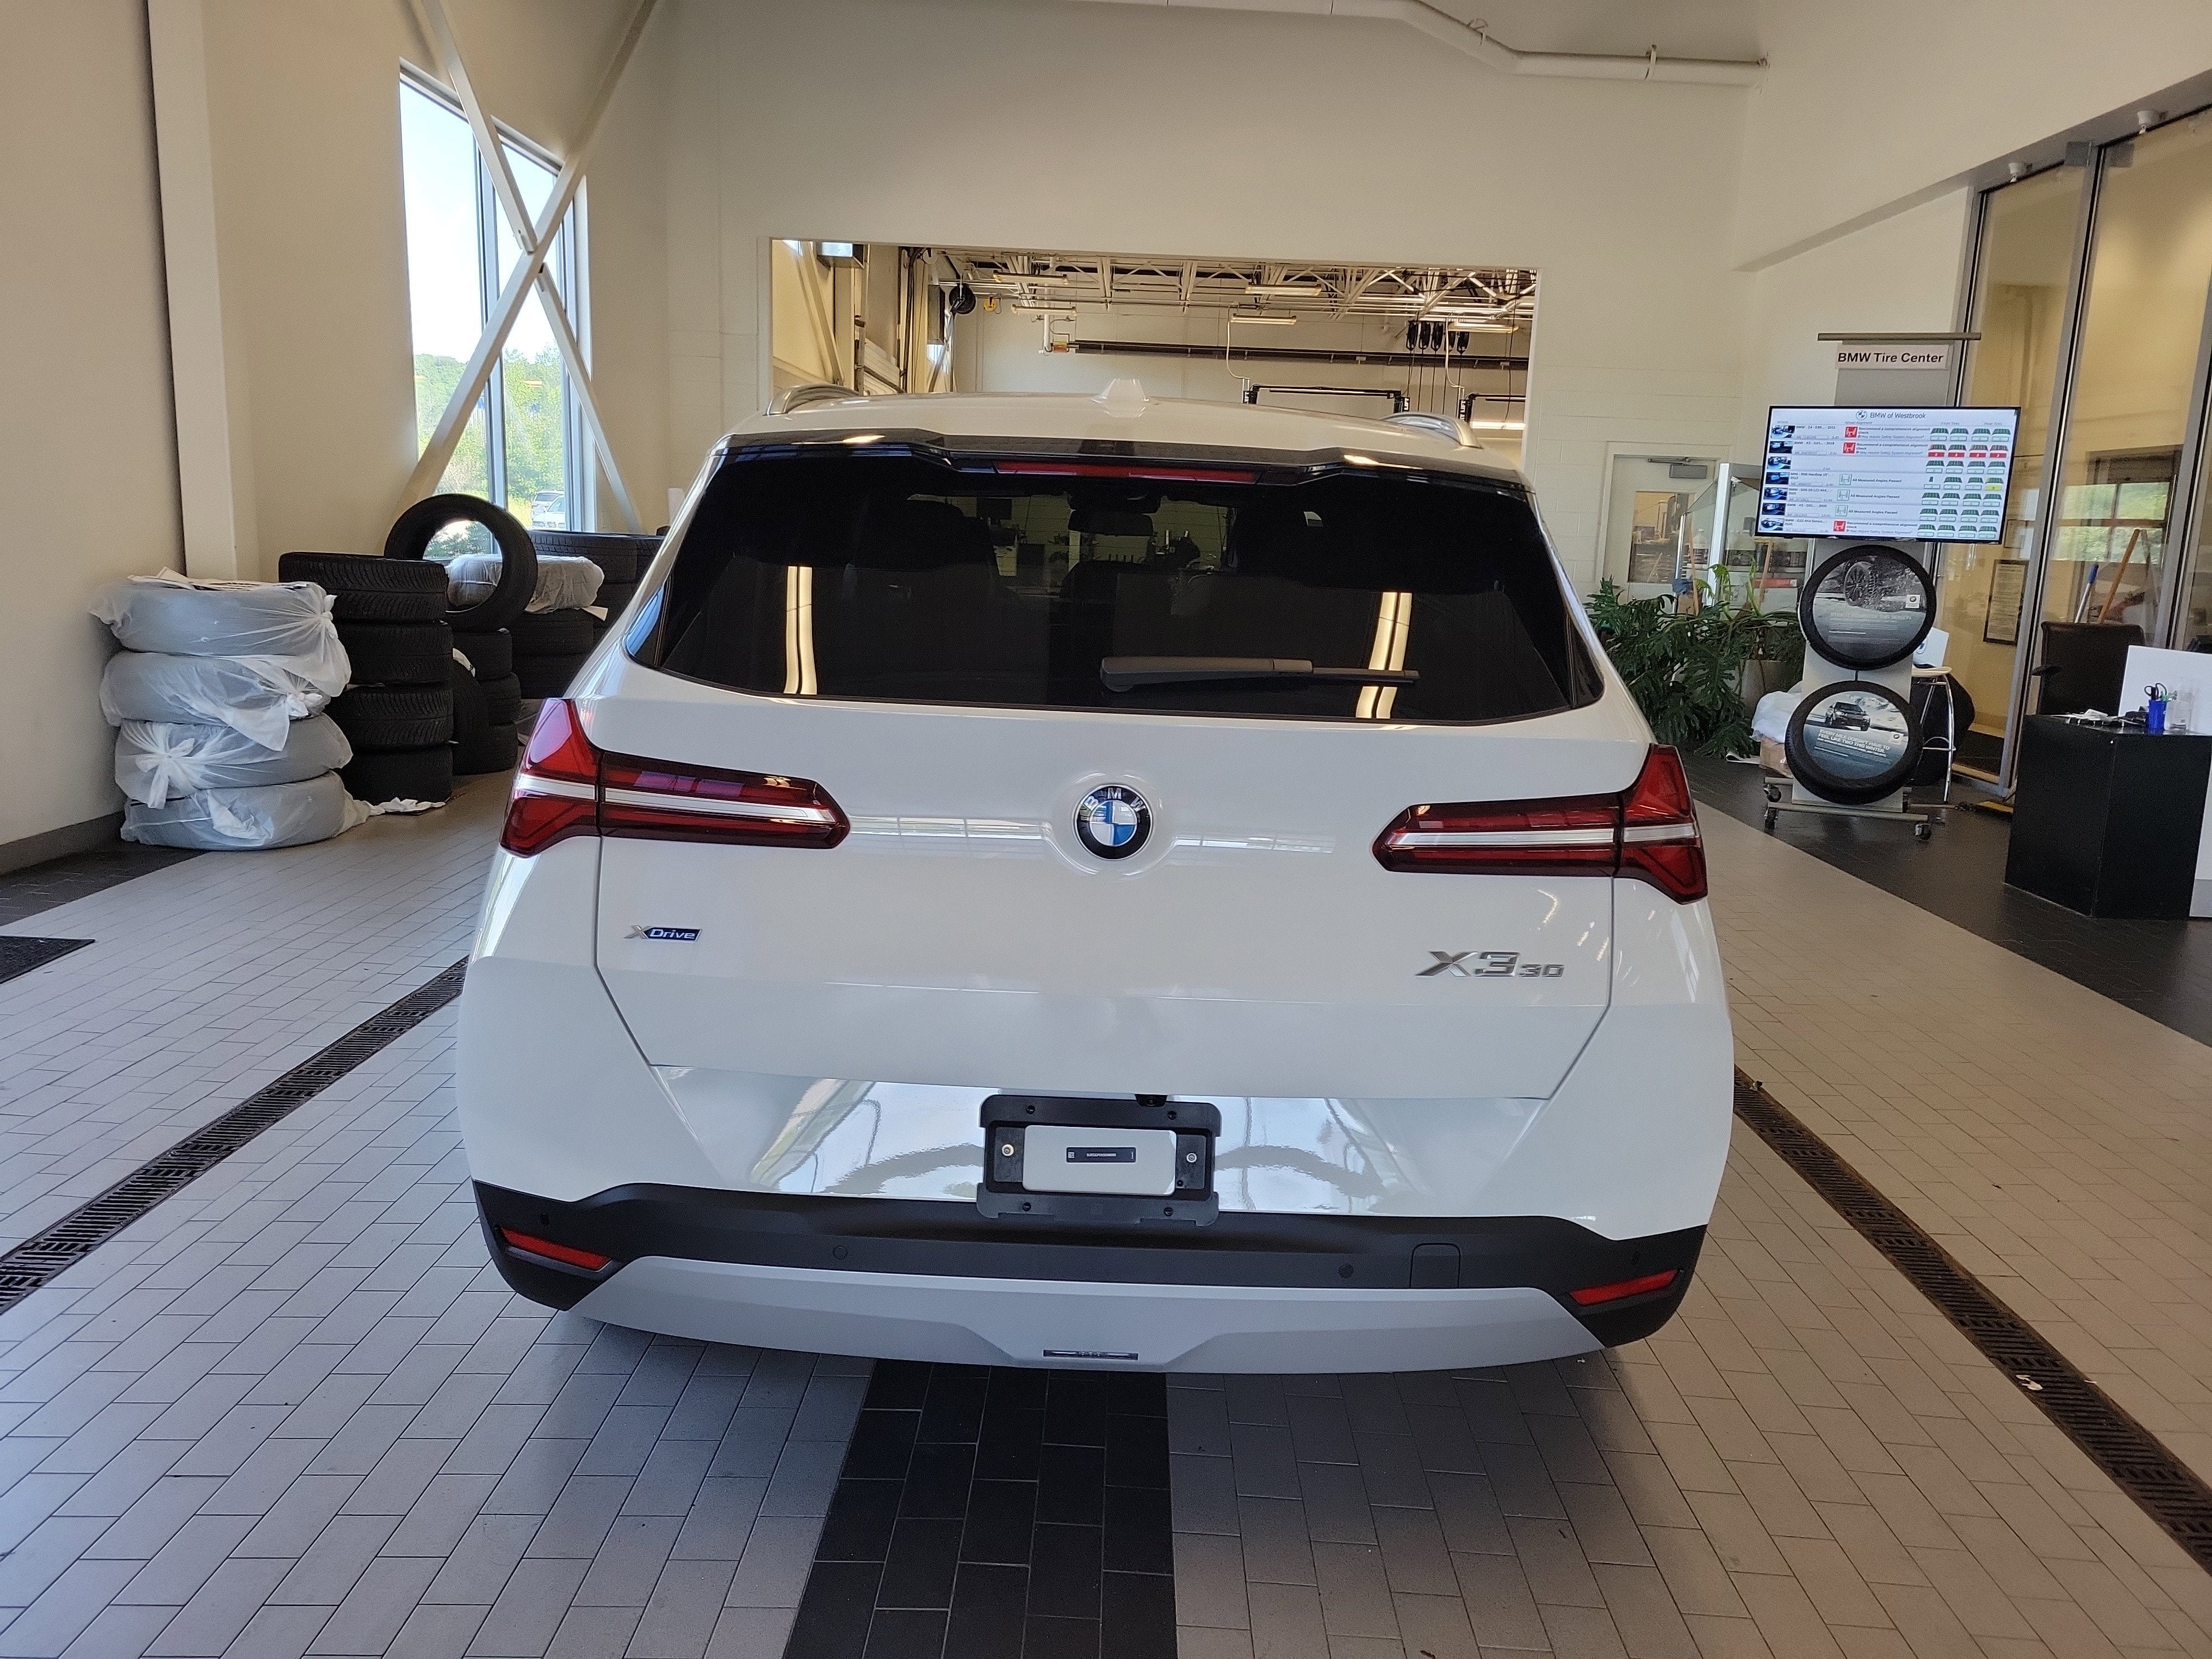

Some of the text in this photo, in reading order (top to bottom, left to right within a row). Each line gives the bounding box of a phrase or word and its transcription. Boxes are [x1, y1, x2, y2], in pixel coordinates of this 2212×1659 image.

[1838, 353, 1944, 362] BMW Tire Center
[1083, 787, 1146, 812] BMW
[1415, 951, 1564, 977] X3 30
